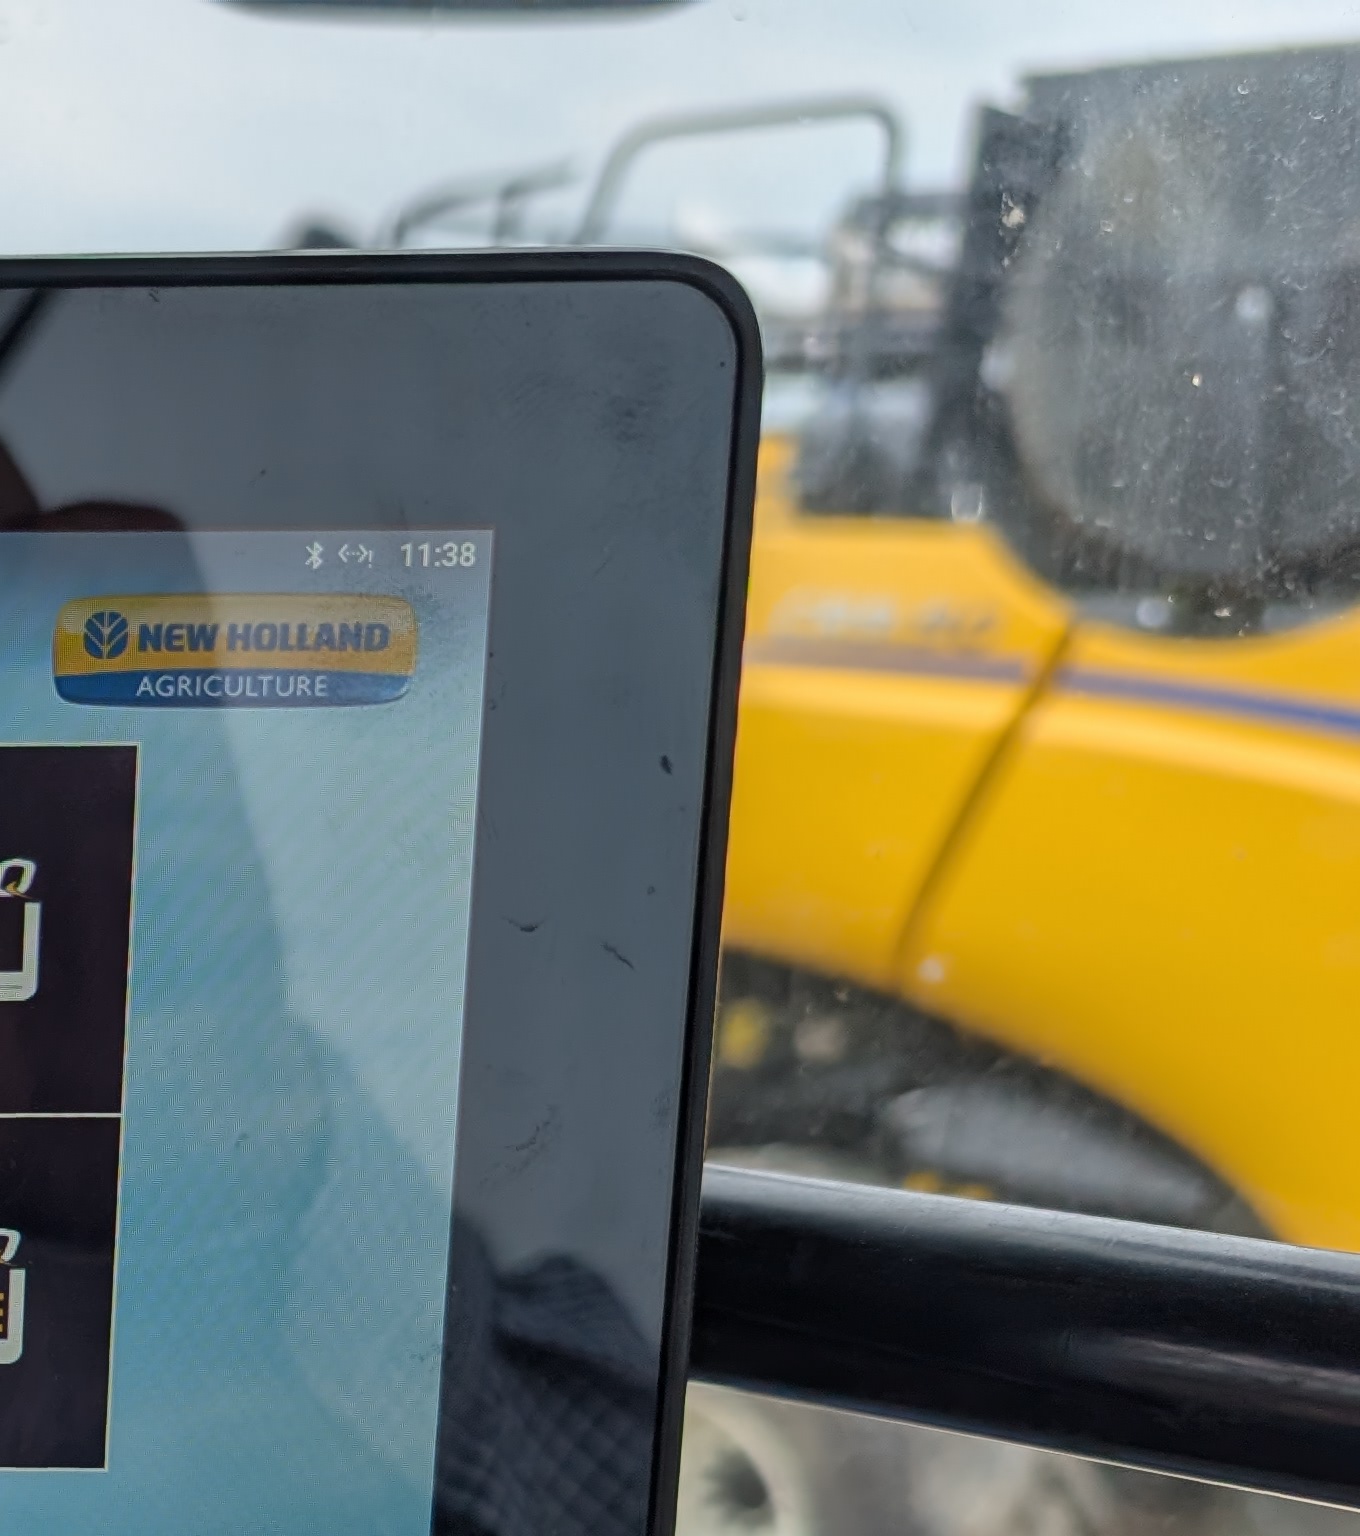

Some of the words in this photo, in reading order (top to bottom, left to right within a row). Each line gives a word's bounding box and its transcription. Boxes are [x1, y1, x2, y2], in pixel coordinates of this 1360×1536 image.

[399, 542, 477, 568] 11:38
[137, 622, 217, 652] NEW
[226, 621, 391, 652] HOLLAND
[135, 674, 328, 698] AGRICULTURE
